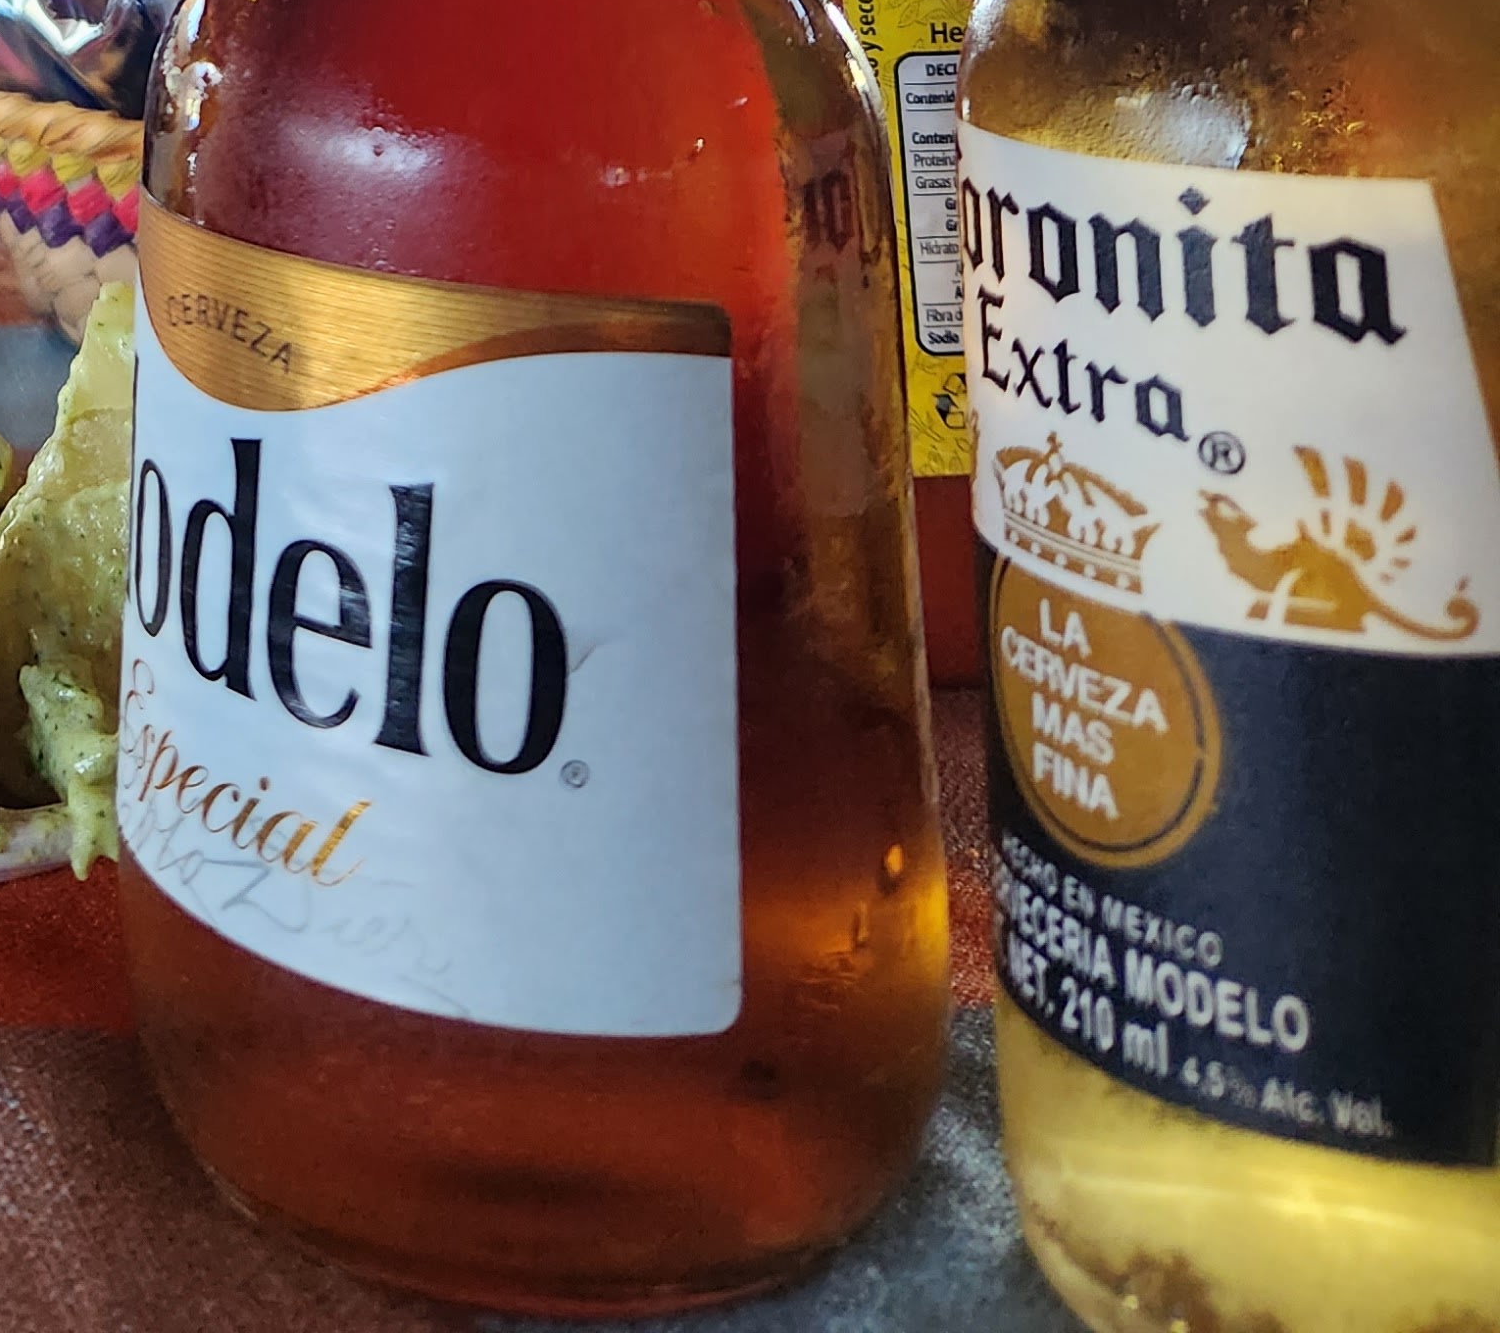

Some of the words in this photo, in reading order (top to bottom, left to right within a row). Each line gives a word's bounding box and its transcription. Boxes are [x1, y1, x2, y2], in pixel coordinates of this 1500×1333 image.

[930, 22, 966, 44] He
[960, 177, 1407, 345] oronita
[163, 292, 296, 376] CERVEZA
[977, 284, 1191, 444] Extra
[129, 438, 568, 773] odelo
[1039, 597, 1091, 658] LA
[1000, 625, 1171, 734] CERVEZA
[1031, 693, 1114, 765] MAS
[122, 658, 372, 886] Especial
[1033, 742, 1120, 821] FINA
[1062, 874, 1095, 919] EN
[1102, 894, 1223, 968] MEXICO
[1059, 976, 1114, 1053] 210
[1122, 1020, 1169, 1078] ml
[1260, 1077, 1324, 1125] Alc.
[1124, 947, 1310, 1053] MODELO
